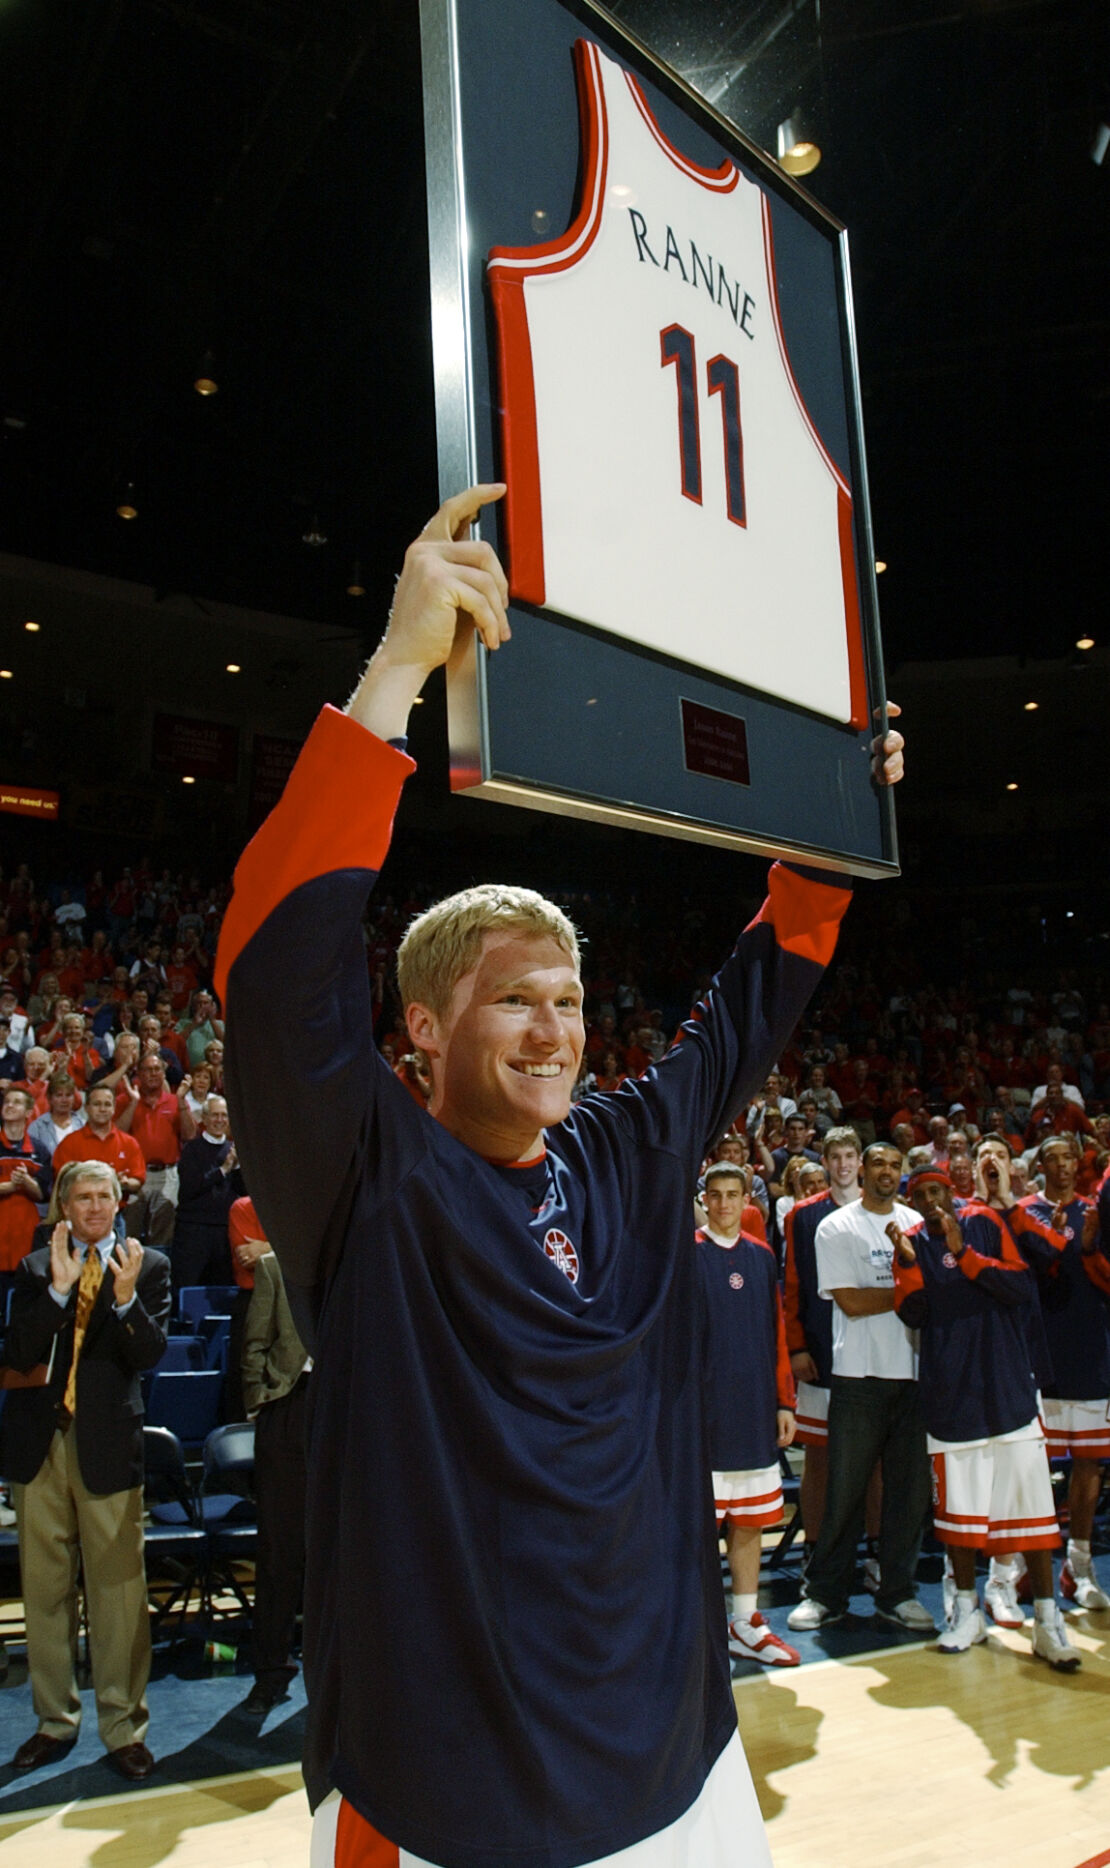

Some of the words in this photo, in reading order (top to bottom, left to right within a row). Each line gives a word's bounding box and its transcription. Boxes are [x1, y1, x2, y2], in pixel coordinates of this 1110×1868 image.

[628, 207, 756, 340] RANNE
[659, 322, 748, 530] 11
[19, 798, 42, 807] need
